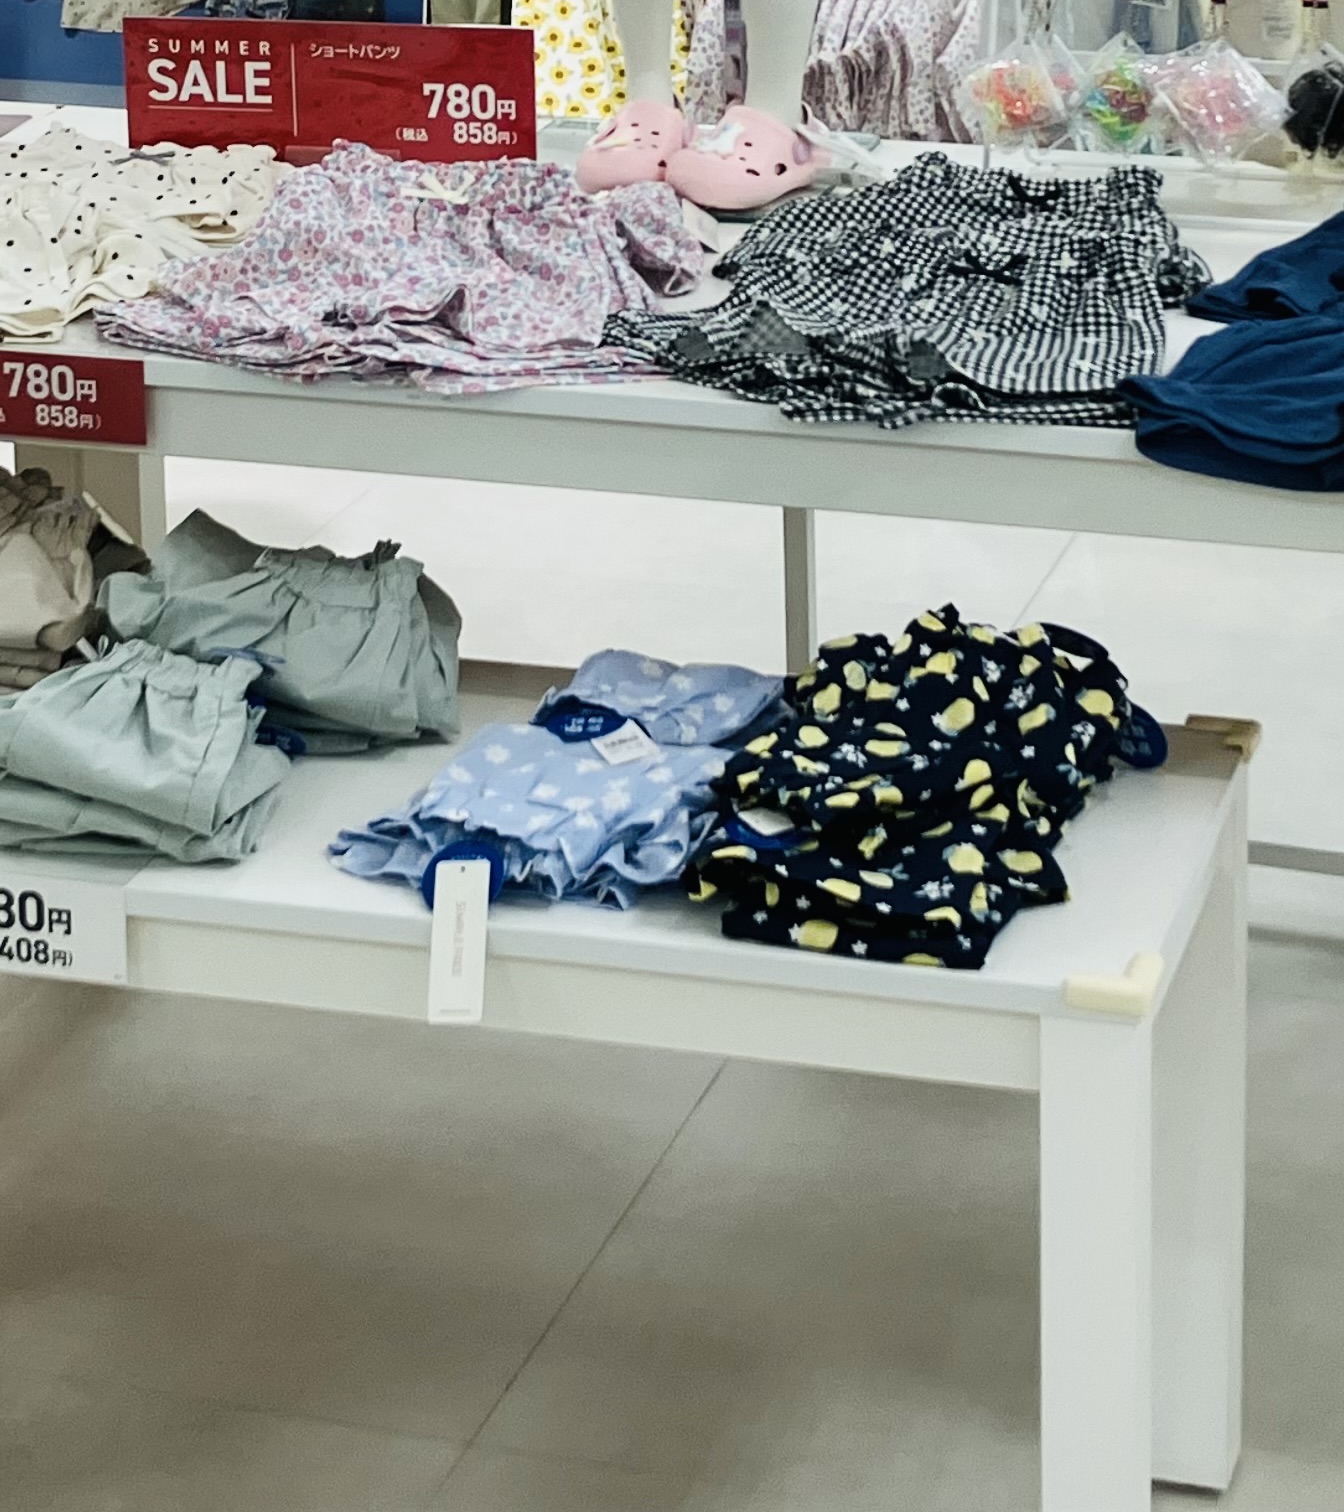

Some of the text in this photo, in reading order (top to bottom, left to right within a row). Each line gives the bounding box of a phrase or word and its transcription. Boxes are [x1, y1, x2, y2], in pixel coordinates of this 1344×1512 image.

[147, 38, 271, 55] SUMMER
[309, 43, 401, 59] ショートパンツ
[147, 59, 273, 104] SALE
[422, 83, 517, 120] 780円
[395, 121, 519, 146] (税込 858円)
[2, 361, 98, 404] 780円
[35, 404, 102, 430] 858円)
